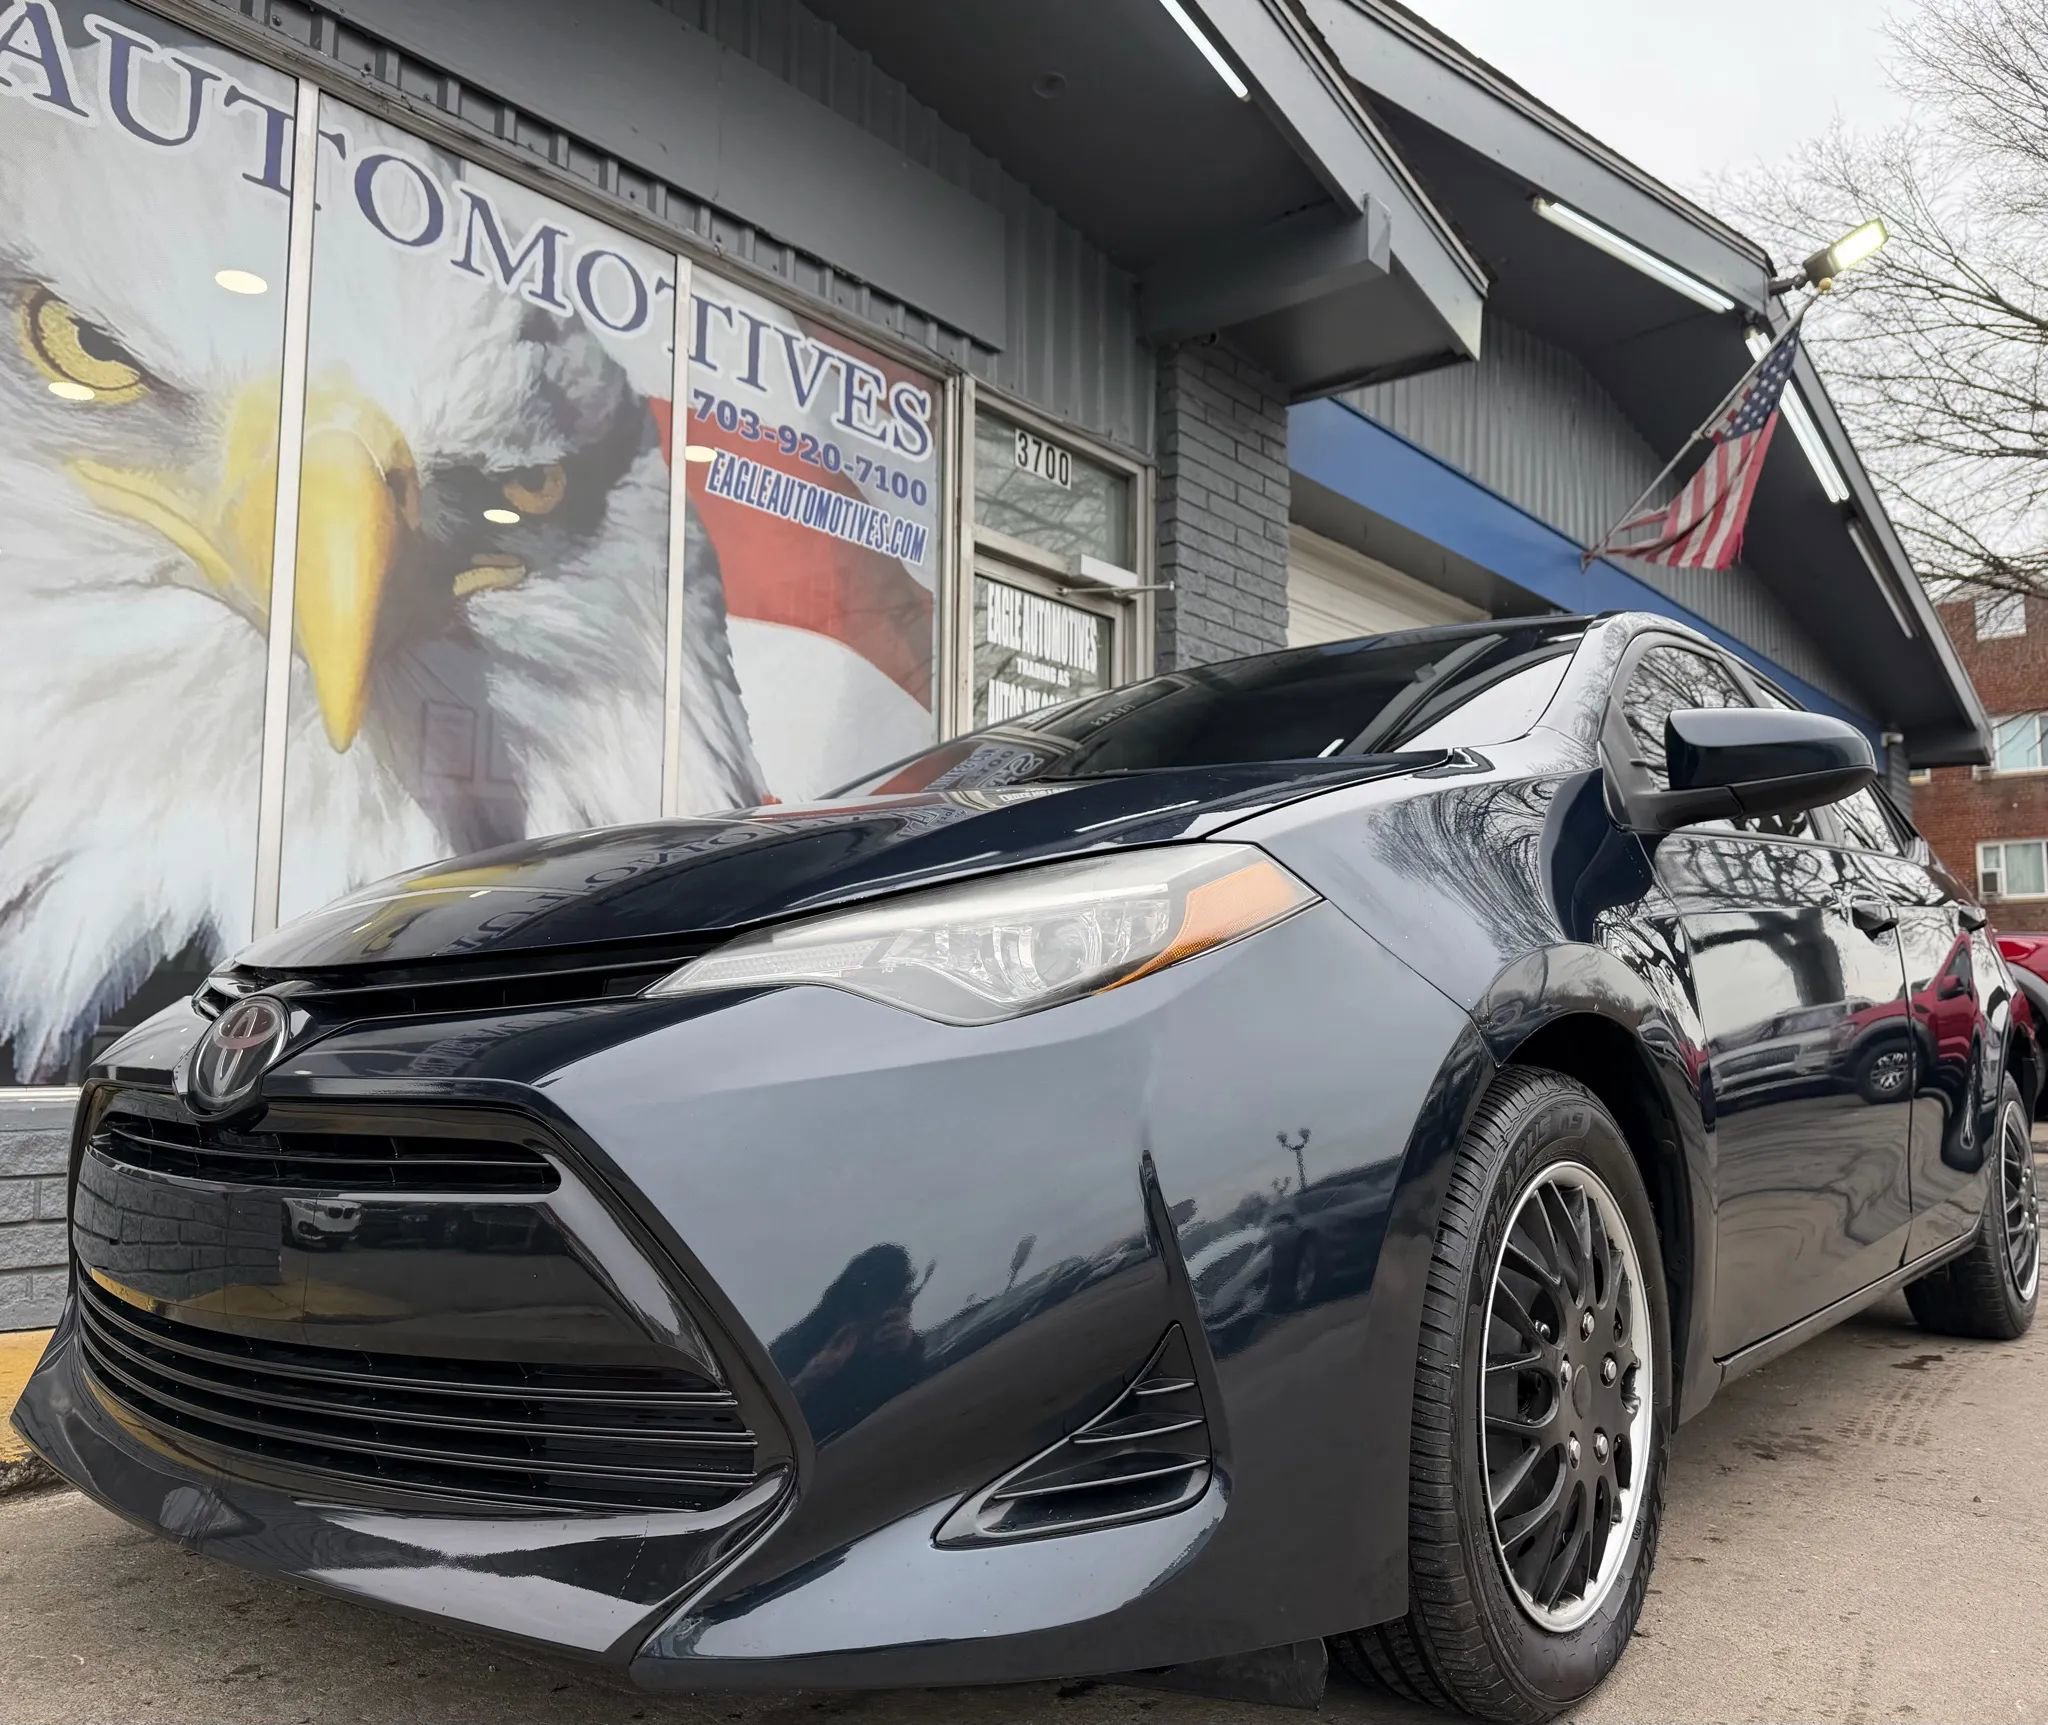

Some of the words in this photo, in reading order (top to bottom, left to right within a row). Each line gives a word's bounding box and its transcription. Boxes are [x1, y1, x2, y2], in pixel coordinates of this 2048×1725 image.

[0, 3, 928, 456] AUTOMOTIVES
[692, 388, 928, 507] 703-920-7100
[1018, 432, 1069, 486] 3700
[707, 450, 928, 564] EAGLEAUTOMOTIVES.COM
[986, 582, 1022, 651] EAGLE
[1022, 593, 1098, 675] AUTOMOTIVES
[1016, 657, 1057, 684] TRADING
[1057, 668, 1071, 688] AS
